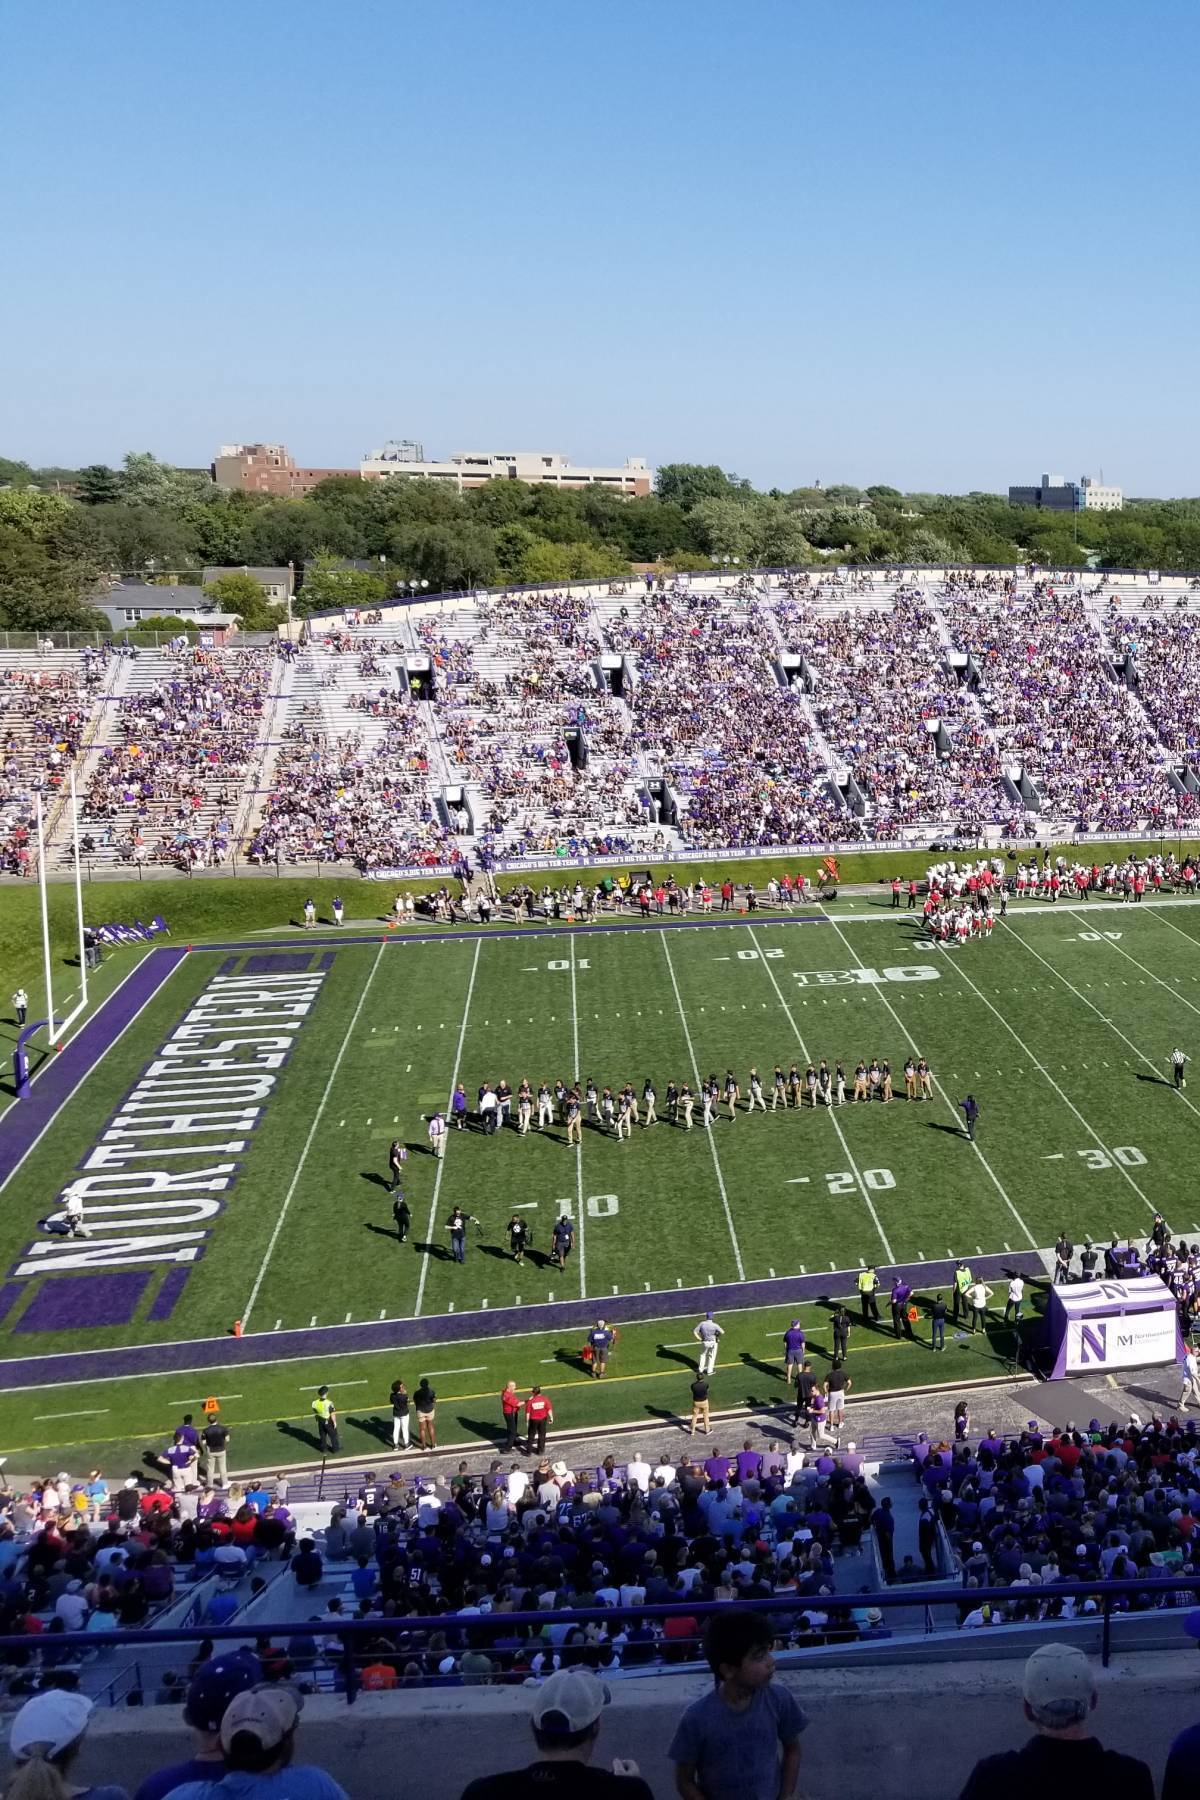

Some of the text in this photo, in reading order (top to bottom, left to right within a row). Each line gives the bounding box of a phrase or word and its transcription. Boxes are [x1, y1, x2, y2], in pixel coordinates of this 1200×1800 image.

[678, 851, 706, 860] CHICAGO'S
[760, 846, 786, 854] CHICAGO'S
[506, 861, 536, 869] CHICAGO'S
[594, 856, 622, 864] CHICAGO'S
[377, 869, 408, 877] CHICAGO'S
[1078, 932, 1123, 941] 40
[736, 948, 785, 960] 20
[548, 957, 591, 971] 10
[15, 971, 326, 1276] NORTHWESTERN
[1077, 1145, 1149, 1170] 30
[826, 1168, 897, 1195] 20
[555, 1194, 619, 1220] 10
[1100, 1282, 1128, 1300] N
[1081, 1323, 1107, 1364] N
[208, 1400, 215, 1409] G
[366, 1494, 375, 1504] 2
[410, 1567, 421, 1581] 51
